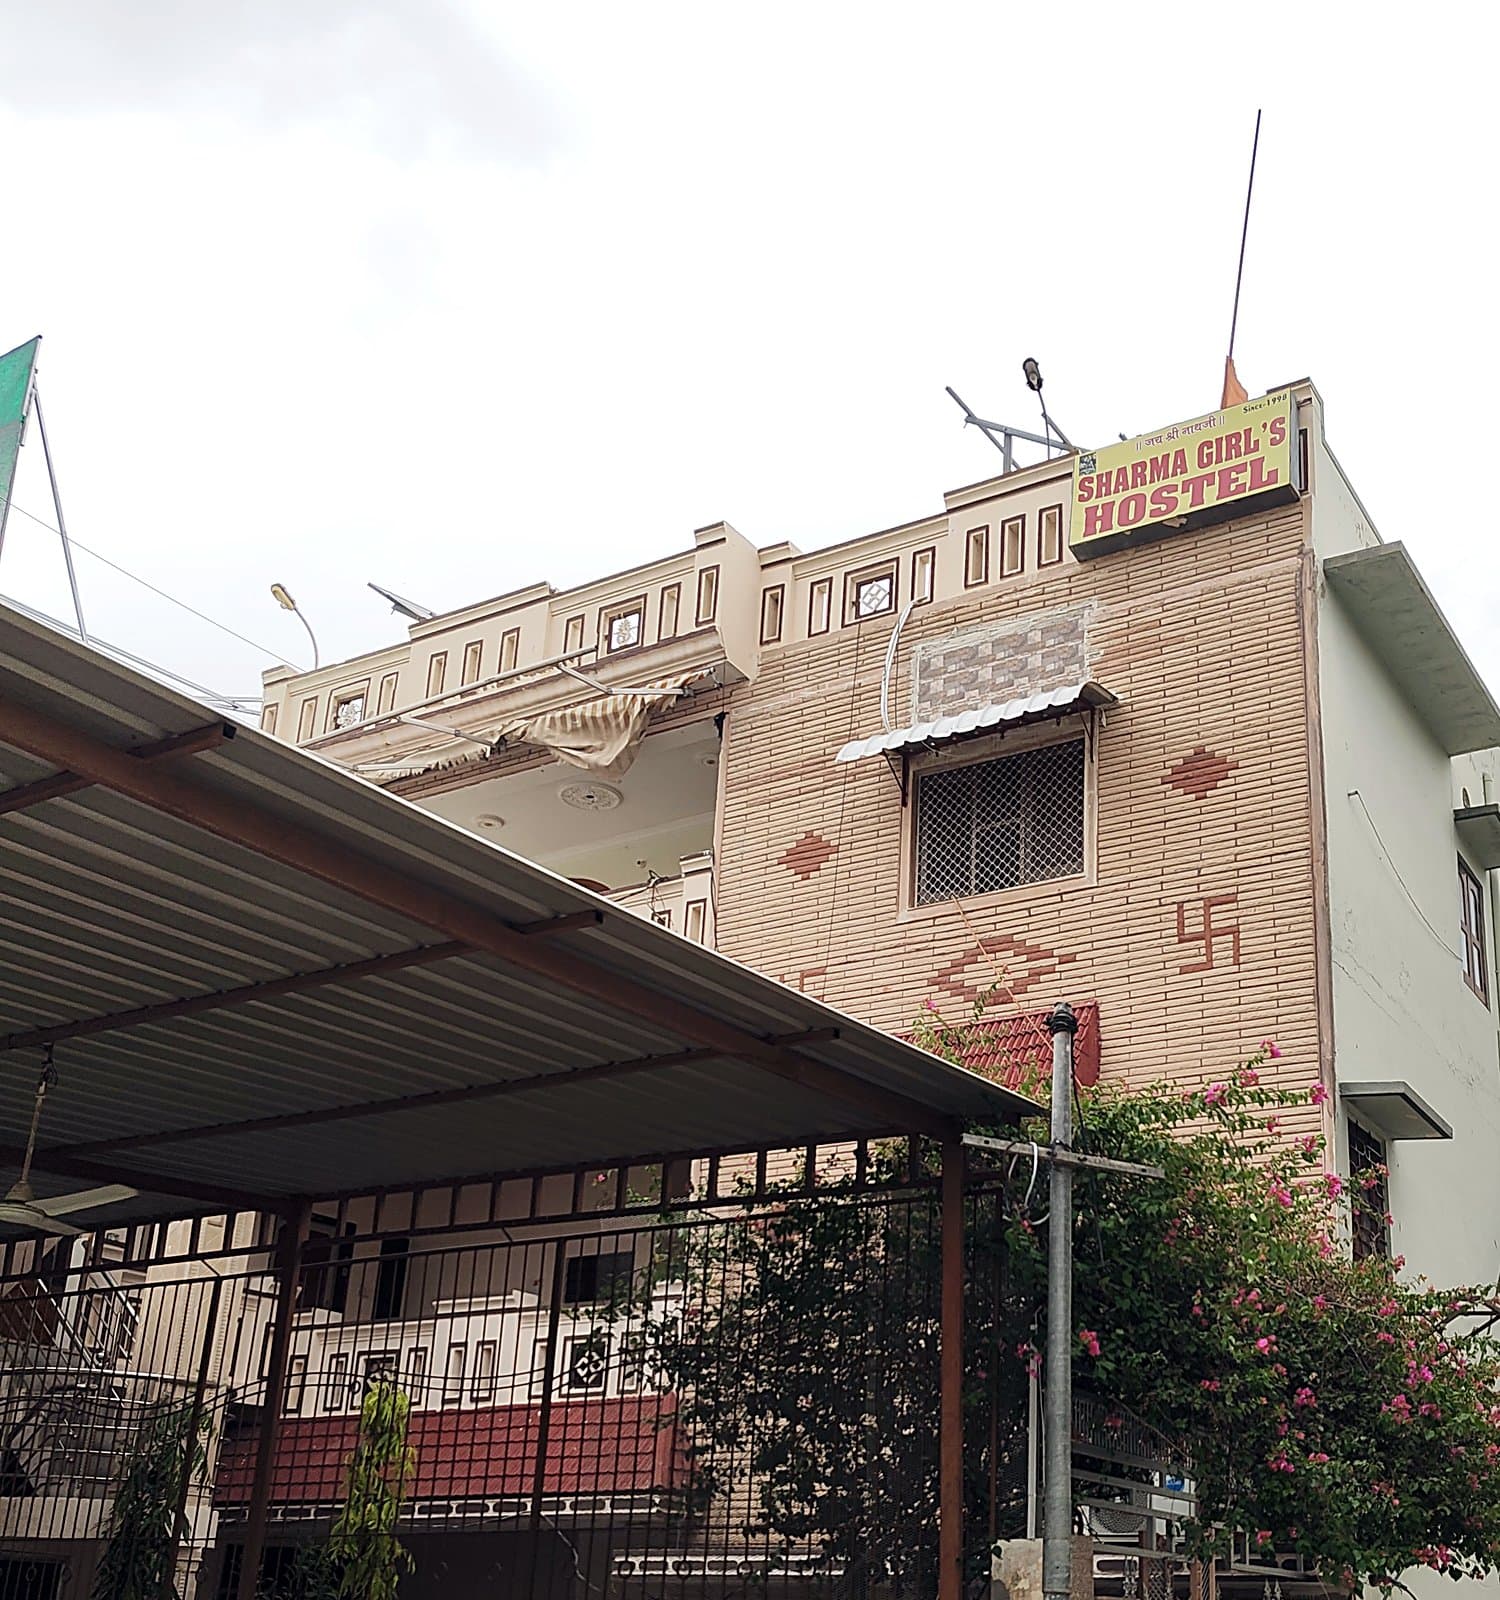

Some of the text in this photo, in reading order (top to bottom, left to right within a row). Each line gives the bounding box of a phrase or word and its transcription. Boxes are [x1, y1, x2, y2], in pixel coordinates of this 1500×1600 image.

[1165, 427, 1179, 441] श्री
[1078, 448, 1188, 503] SHARMA
[1083, 456, 1279, 538] HOSTEL
